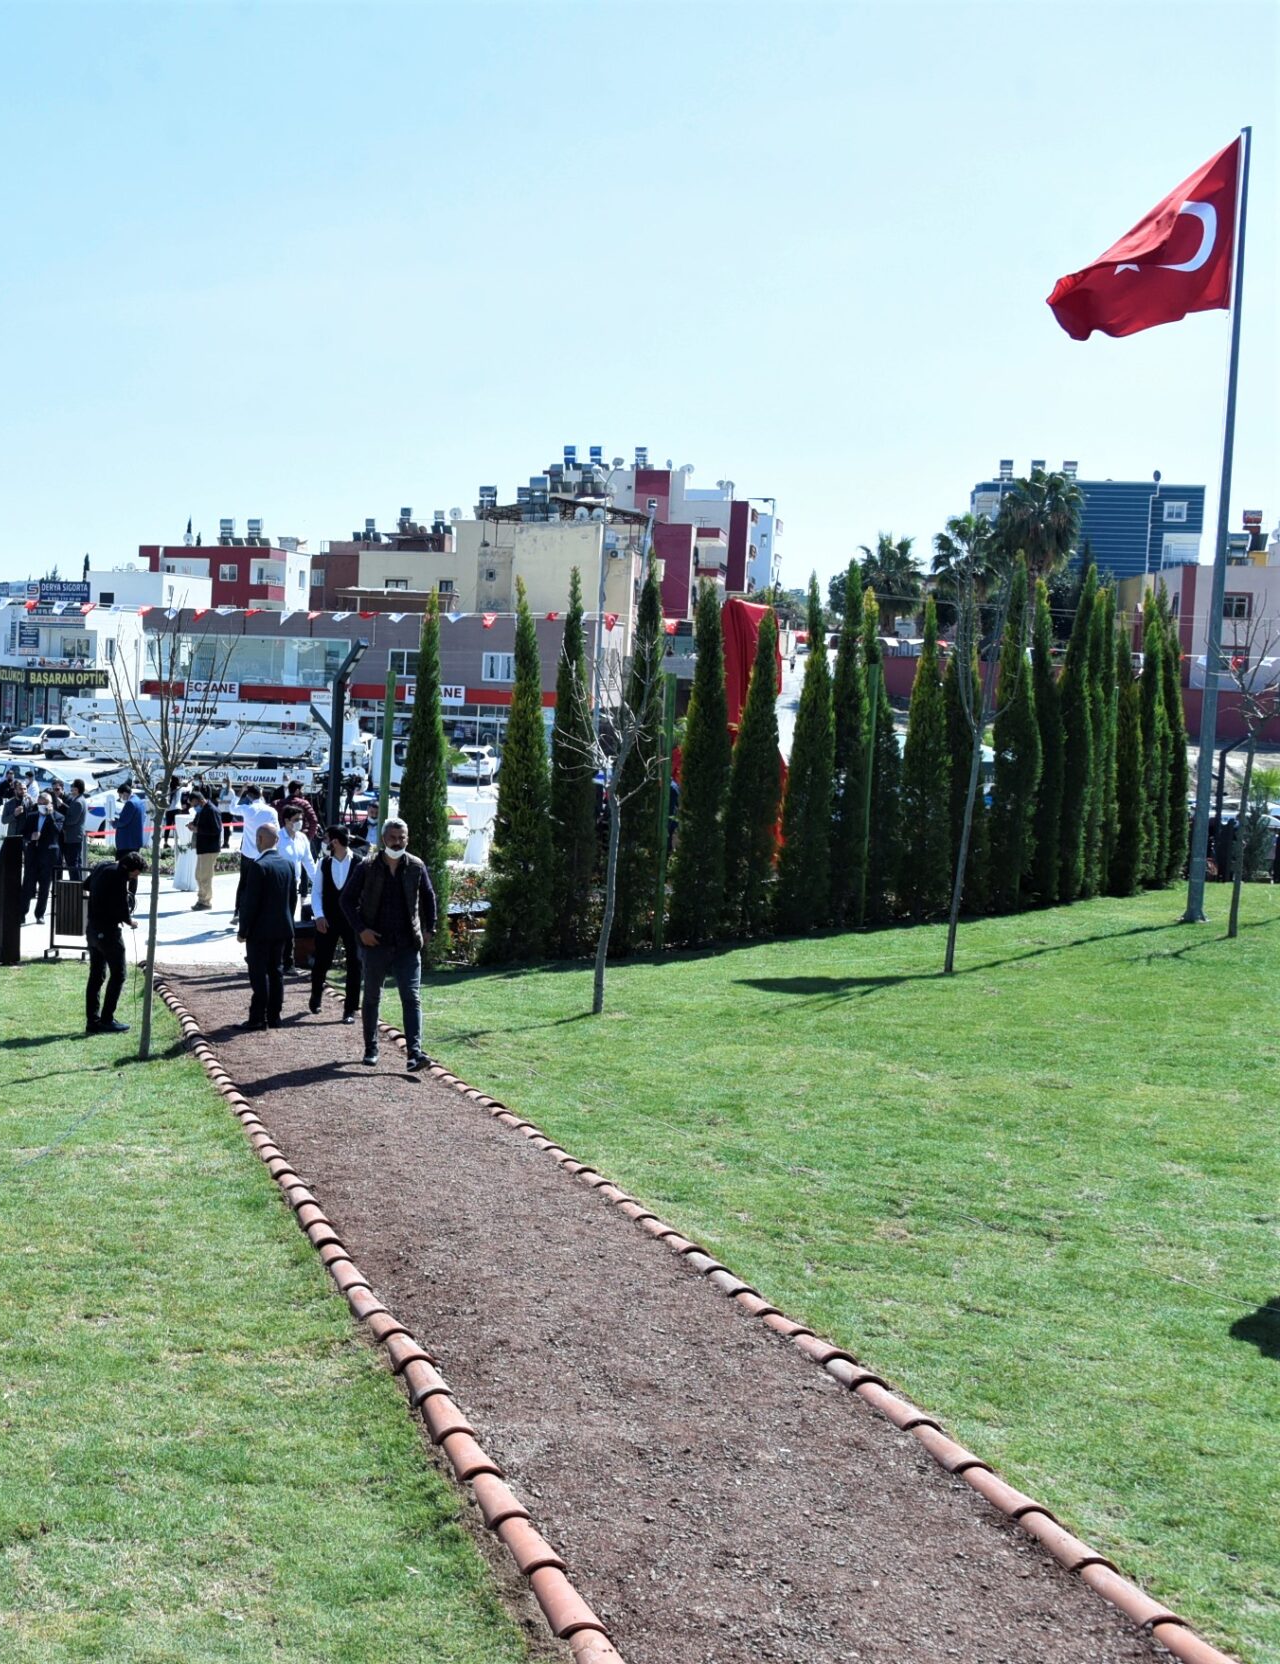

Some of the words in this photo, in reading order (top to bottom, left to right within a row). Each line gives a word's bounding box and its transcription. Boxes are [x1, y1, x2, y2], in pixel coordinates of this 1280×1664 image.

[41, 583, 61, 592] DERYA
[29, 671, 75, 686] BAŞARAN
[75, 670, 106, 685] OPTİK
[187, 681, 237, 694] ECZANE
[407, 686, 463, 698] ENE
[208, 770, 229, 778] BETON
[236, 774, 277, 783] KOLUMAN
